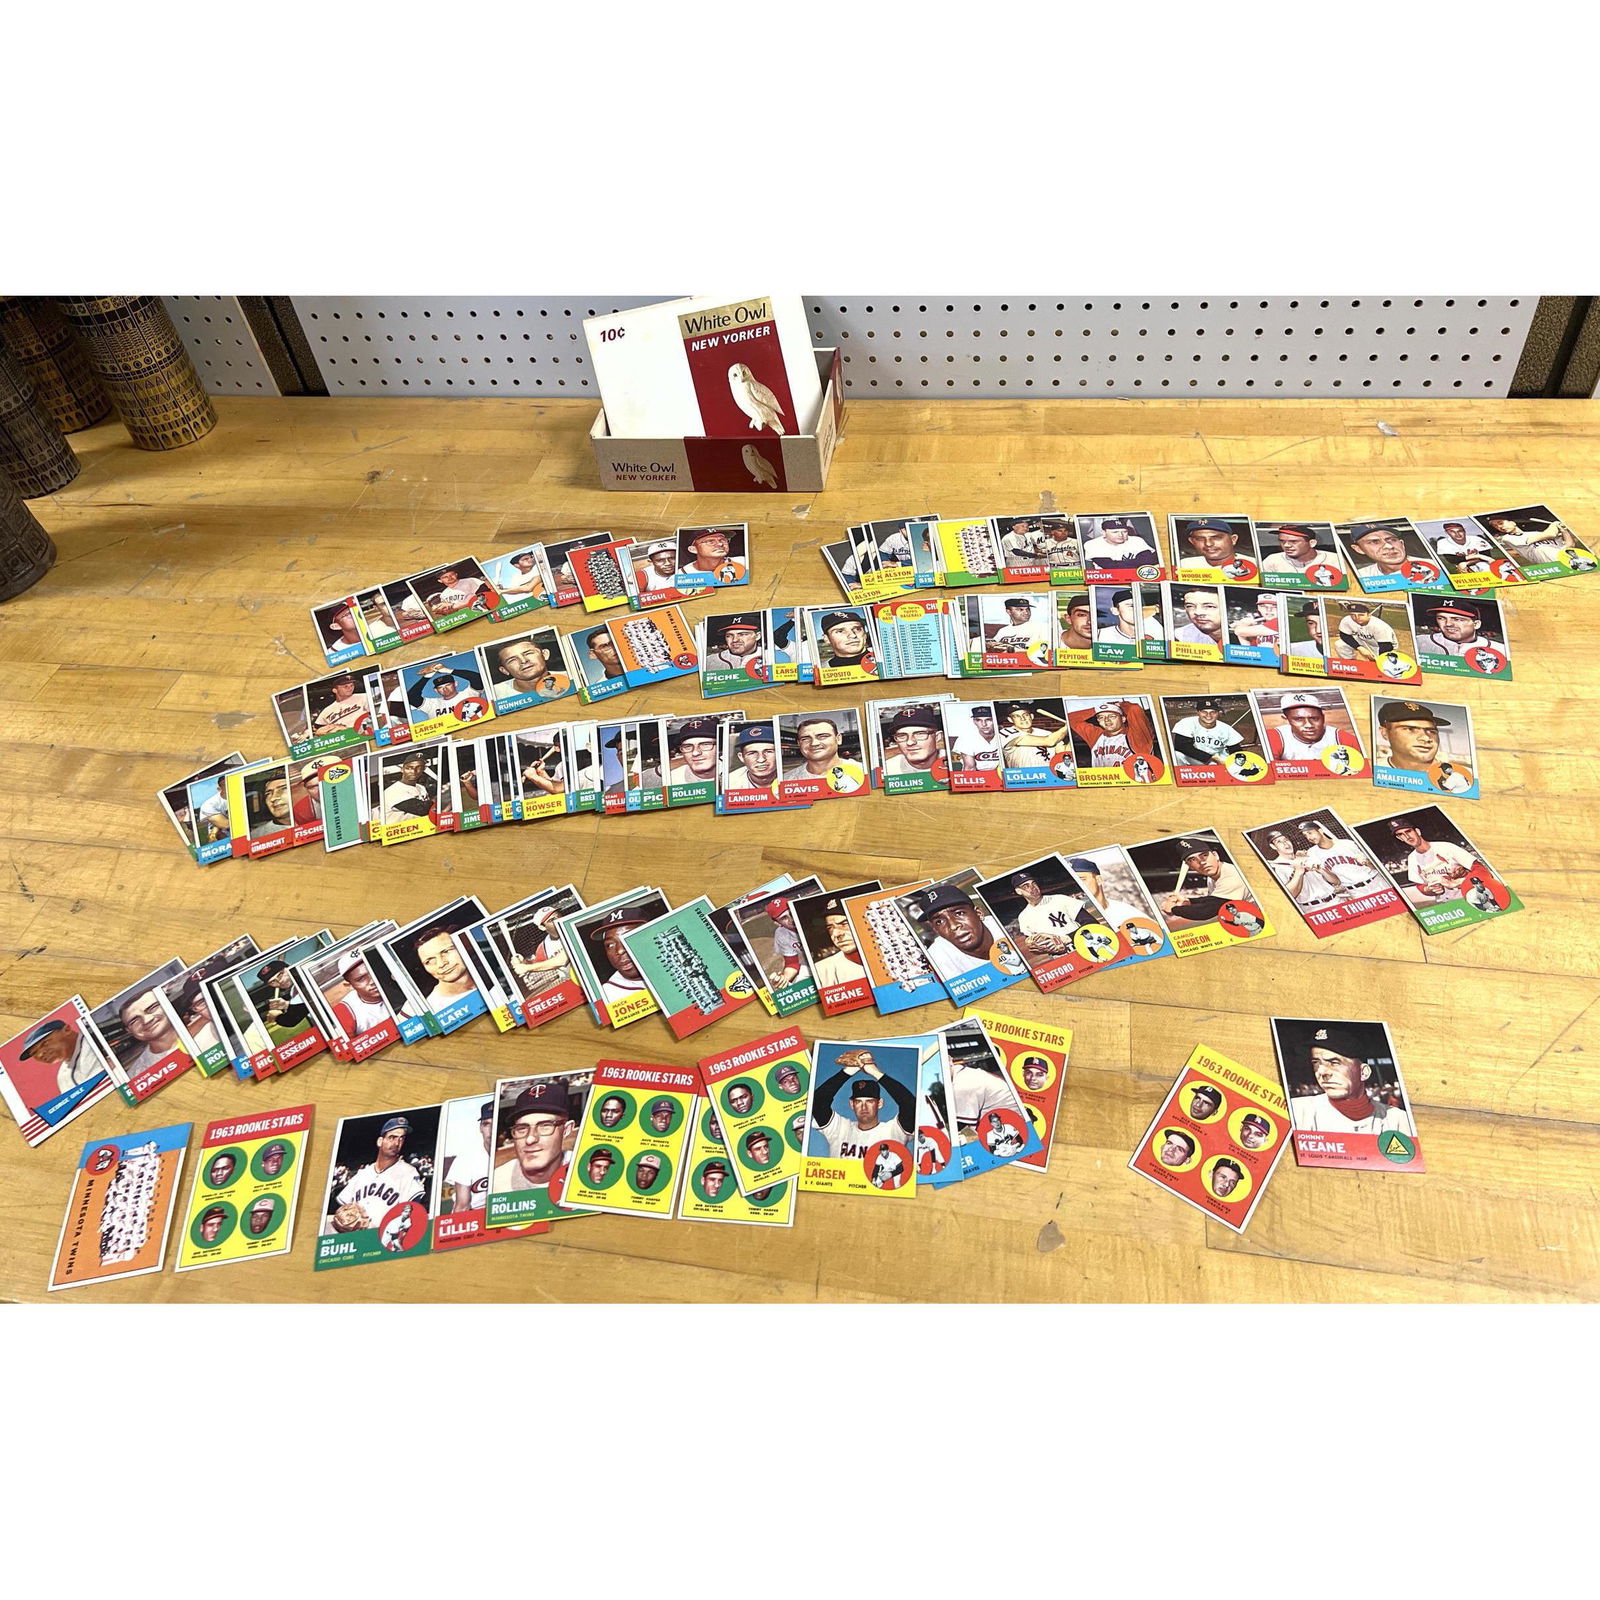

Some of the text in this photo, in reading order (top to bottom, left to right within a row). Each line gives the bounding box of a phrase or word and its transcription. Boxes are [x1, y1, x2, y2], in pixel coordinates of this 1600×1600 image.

[684, 304, 766, 334] White Owl
[600, 326, 626, 343] 10¢
[690, 326, 771, 352] NEW YORKER
[612, 462, 675, 473] White Owl
[884, 570, 912, 578] ALSTON
[1526, 566, 1562, 577] KALINE
[1364, 578, 1396, 587] HODGES
[1454, 576, 1490, 585] WILHELM
[640, 593, 666, 602] SEGUI
[854, 590, 882, 600] ALSTON
[502, 602, 529, 616] SMITH
[436, 612, 468, 629] FOYTACK
[402, 624, 431, 638] STAFFORD
[1175, 648, 1212, 656] PHILLIPS
[1230, 650, 1262, 658] EDWARDS
[1332, 663, 1358, 672] KING
[1420, 659, 1458, 668] PICHE
[706, 673, 740, 682] PICHE
[822, 671, 852, 679] ESPOSITO
[591, 682, 624, 696] SISLER
[498, 697, 533, 711] RUNNELS
[414, 722, 444, 735] LARSEN
[314, 735, 346, 749] STANGE
[1006, 772, 1047, 782] LOLLAR
[1180, 771, 1216, 780] NIXON
[1276, 766, 1309, 774] SEGUI
[888, 778, 924, 788] ROLLINS
[954, 776, 986, 785] LILLIS
[1078, 774, 1120, 782] BROSNAN
[1376, 774, 1423, 786] AMALFITANO
[672, 788, 708, 798] ROLLINS
[784, 785, 820, 794] DAVIS
[728, 793, 768, 802] LANDRUM
[526, 800, 562, 812] HOWSER
[386, 824, 420, 837] GREEN
[252, 836, 286, 853] UMBRICHT
[1309, 909, 1340, 926] TRIBE
[1342, 892, 1398, 917] THUMPERS
[1424, 909, 1465, 927] BROGLIO
[694, 908, 738, 969] WASHINGTON SENATORS
[1173, 932, 1194, 940] CAMILO
[1176, 934, 1211, 949] CARREON
[1037, 962, 1075, 985] STAFFORD
[823, 986, 846, 996] JOHNNY
[952, 974, 992, 996] MORTON
[778, 986, 816, 1007] TORRE
[825, 988, 864, 1005] KEANE
[528, 993, 565, 1016] FREESE
[613, 997, 649, 1018] JONES
[440, 1004, 470, 1027] LARY
[352, 1034, 369, 1046] DIEGO
[994, 1022, 1032, 1040] ROOKIE
[1032, 1030, 1065, 1046] STARS
[277, 1040, 296, 1054] CHUCK
[279, 1035, 317, 1060] ESSEGIAN
[354, 1030, 390, 1054] SEGUI
[708, 1036, 798, 1076] 1963 ROOKIE STARS
[136, 1061, 178, 1093] DAVIS
[602, 1066, 694, 1086] 1963 ROOKIE STARS
[1196, 1054, 1222, 1074] 1963
[1222, 1070, 1262, 1096] ROOKIE
[210, 1113, 305, 1140] 1963 ROOKIE STARS
[1298, 1141, 1346, 1154] KEANE
[804, 1168, 846, 1180] LARSEN
[492, 1196, 508, 1204] RICH
[491, 1200, 538, 1215] ROLLINS
[65, 1178, 96, 1276] MINNESOTA TWINS
[438, 1220, 480, 1237] LILLIS
[320, 1242, 358, 1258] BUHL
